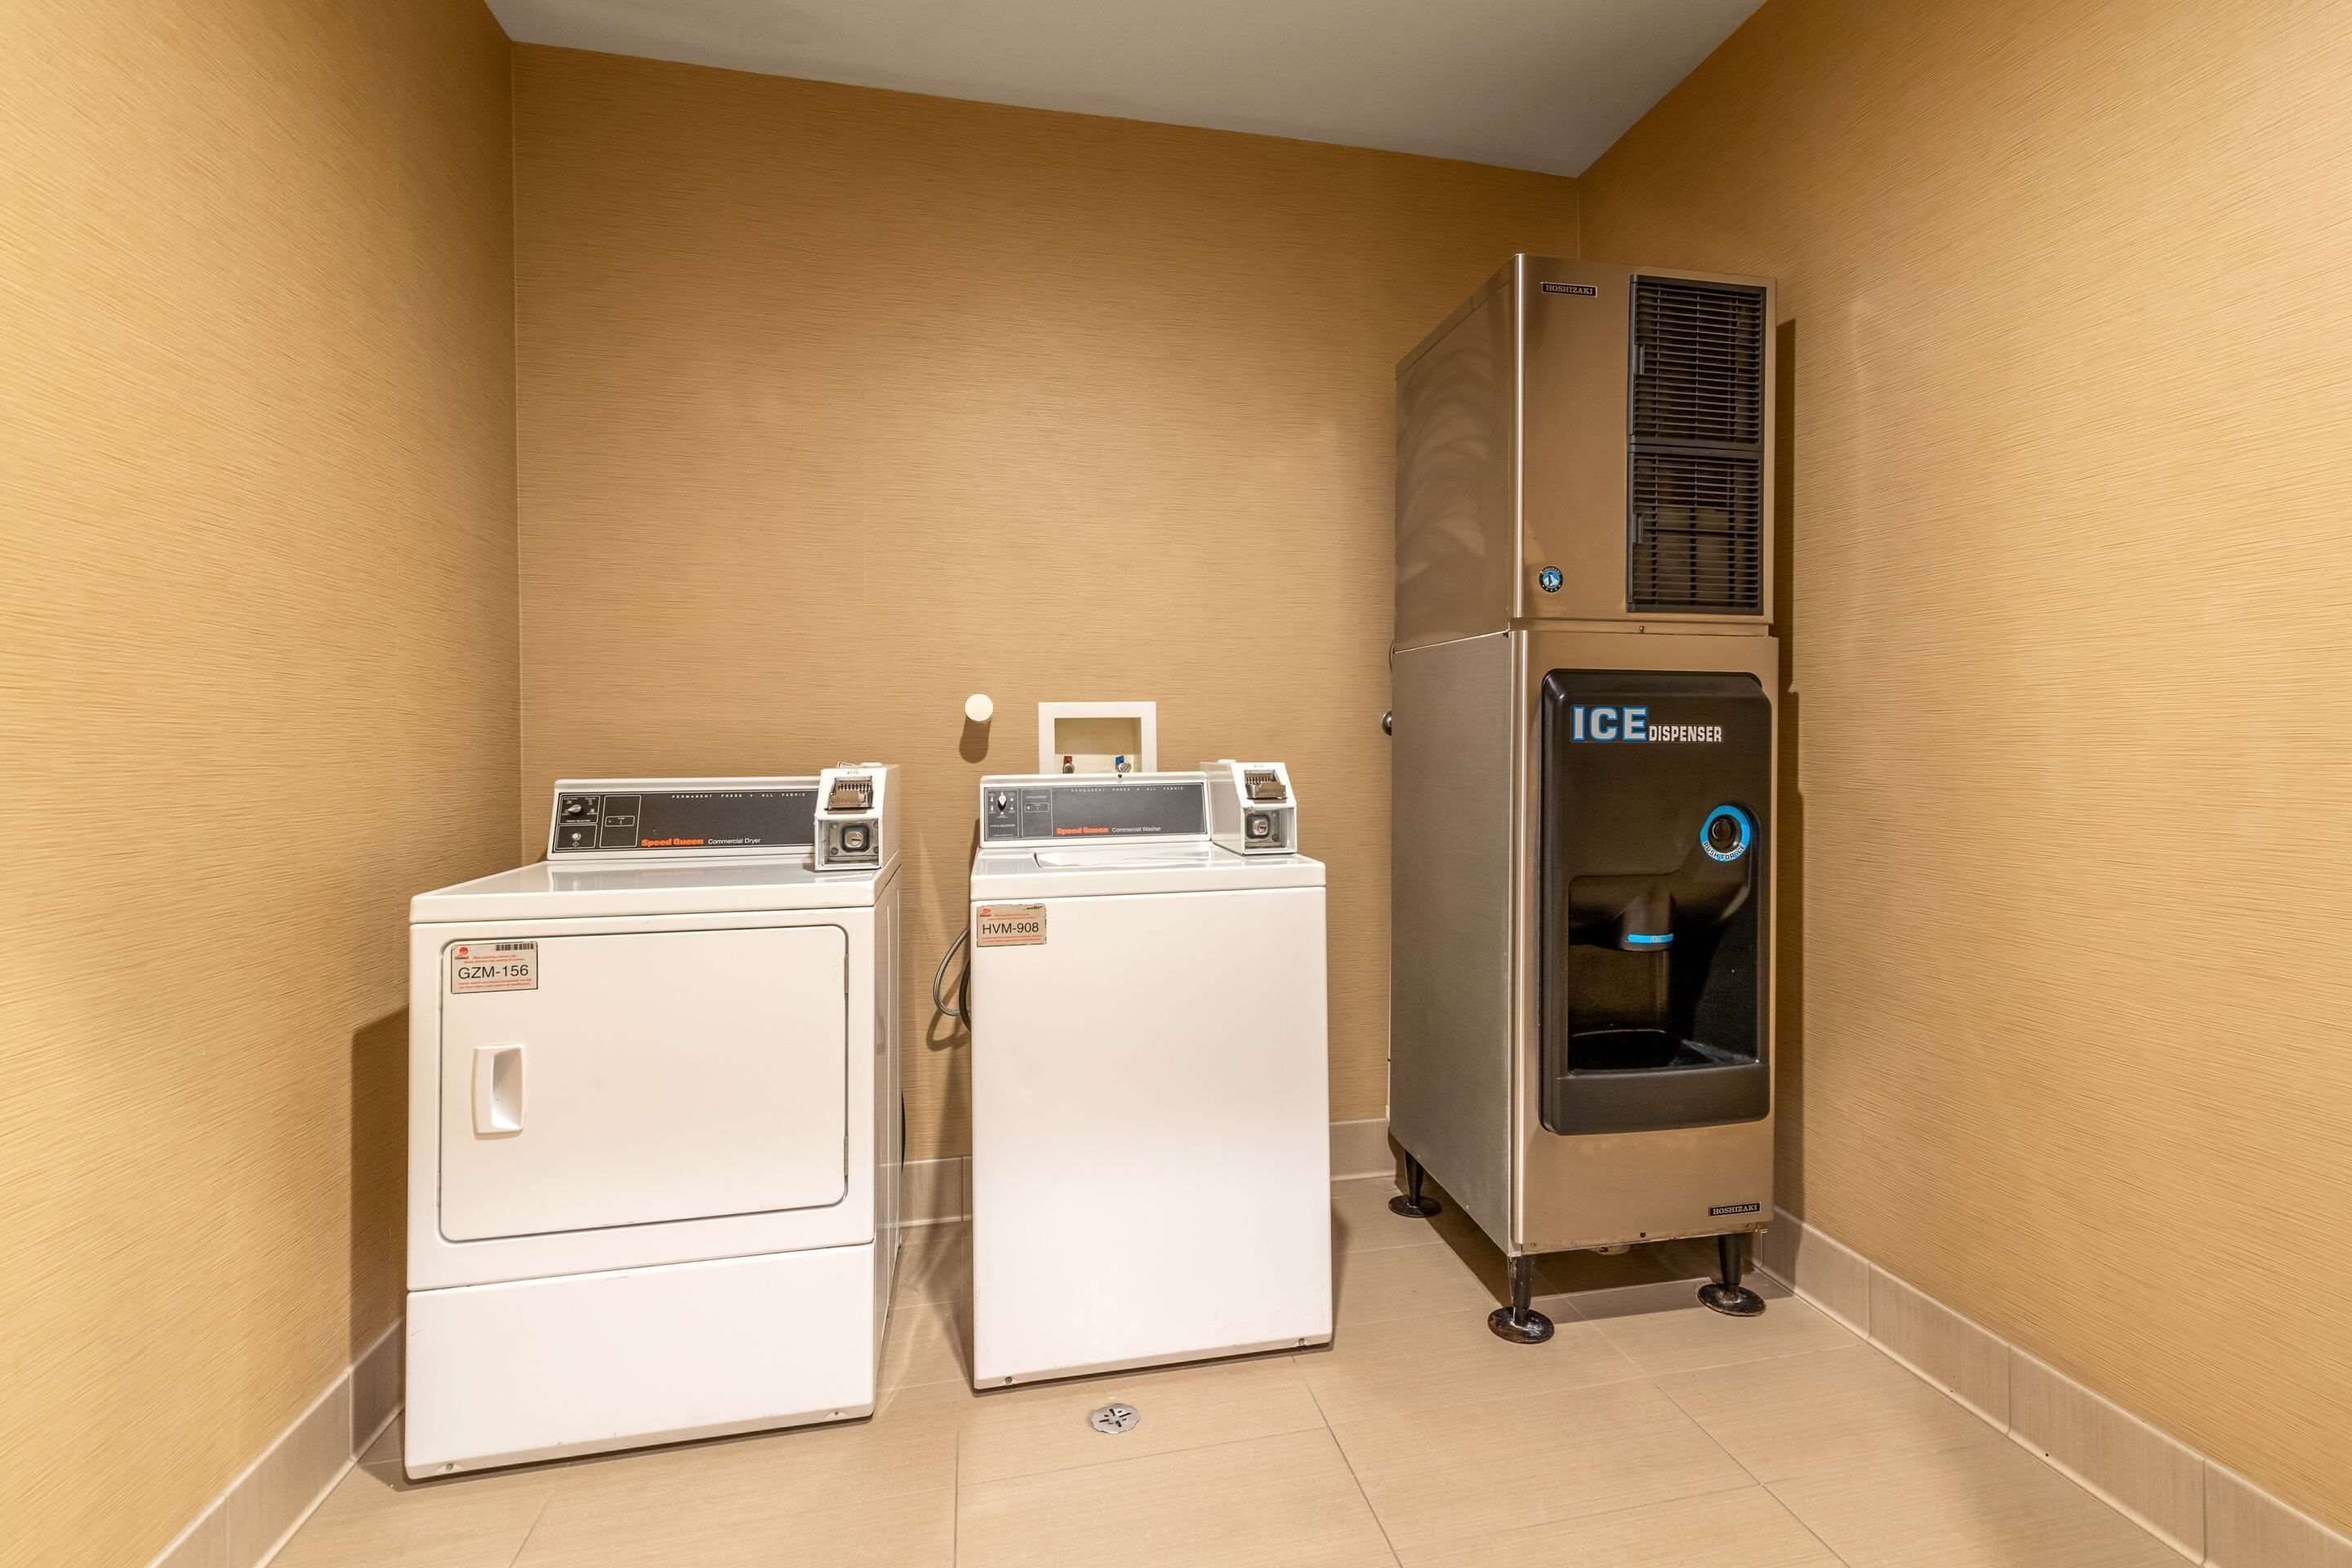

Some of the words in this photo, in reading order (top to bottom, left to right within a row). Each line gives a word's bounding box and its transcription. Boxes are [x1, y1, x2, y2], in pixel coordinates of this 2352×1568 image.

[1546, 284, 1593, 295] HOSHIZAKI
[1572, 705, 1647, 742] ICE
[1649, 725, 1722, 742] DISPENSER
[641, 838, 672, 847] Speed
[673, 838, 704, 846] Queen
[1703, 842, 1719, 858] PUSH
[982, 922, 1039, 934] HVM-908
[458, 964, 529, 979] GZM-156
[1713, 1205, 1757, 1214] HOSHIZAKI
